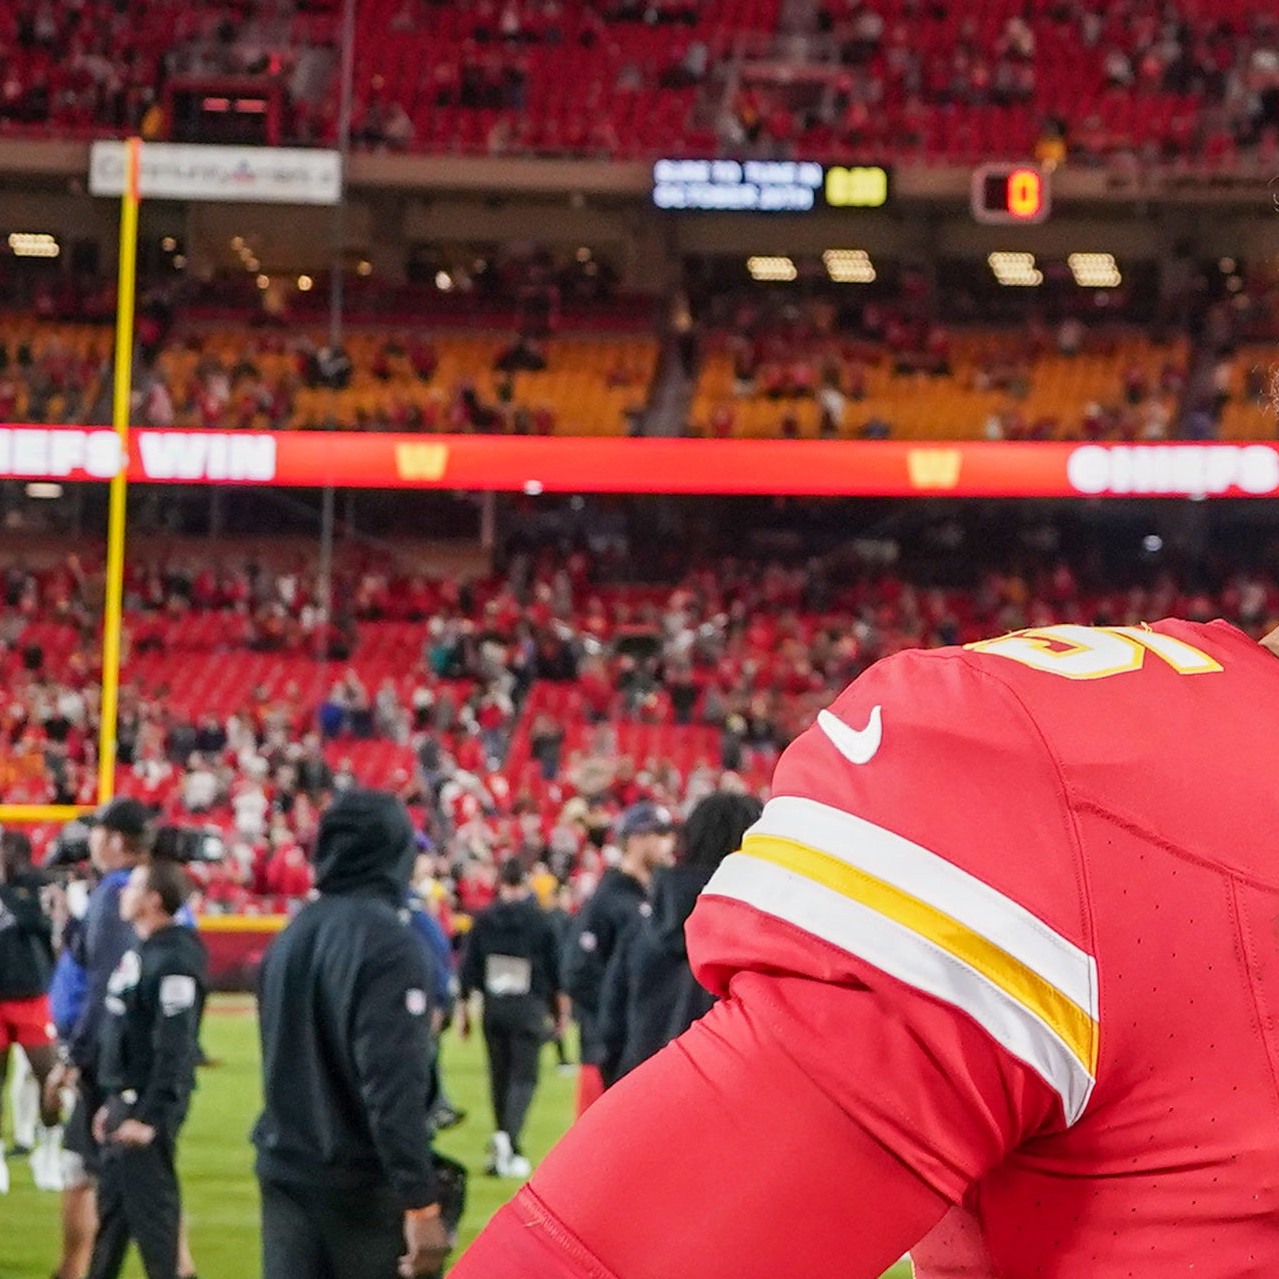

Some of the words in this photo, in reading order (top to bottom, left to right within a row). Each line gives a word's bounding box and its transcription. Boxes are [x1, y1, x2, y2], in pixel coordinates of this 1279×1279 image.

[1007, 168, 1041, 220] 0
[138, 432, 276, 481] WIN
[395, 442, 448, 480] W
[907, 448, 962, 489] W
